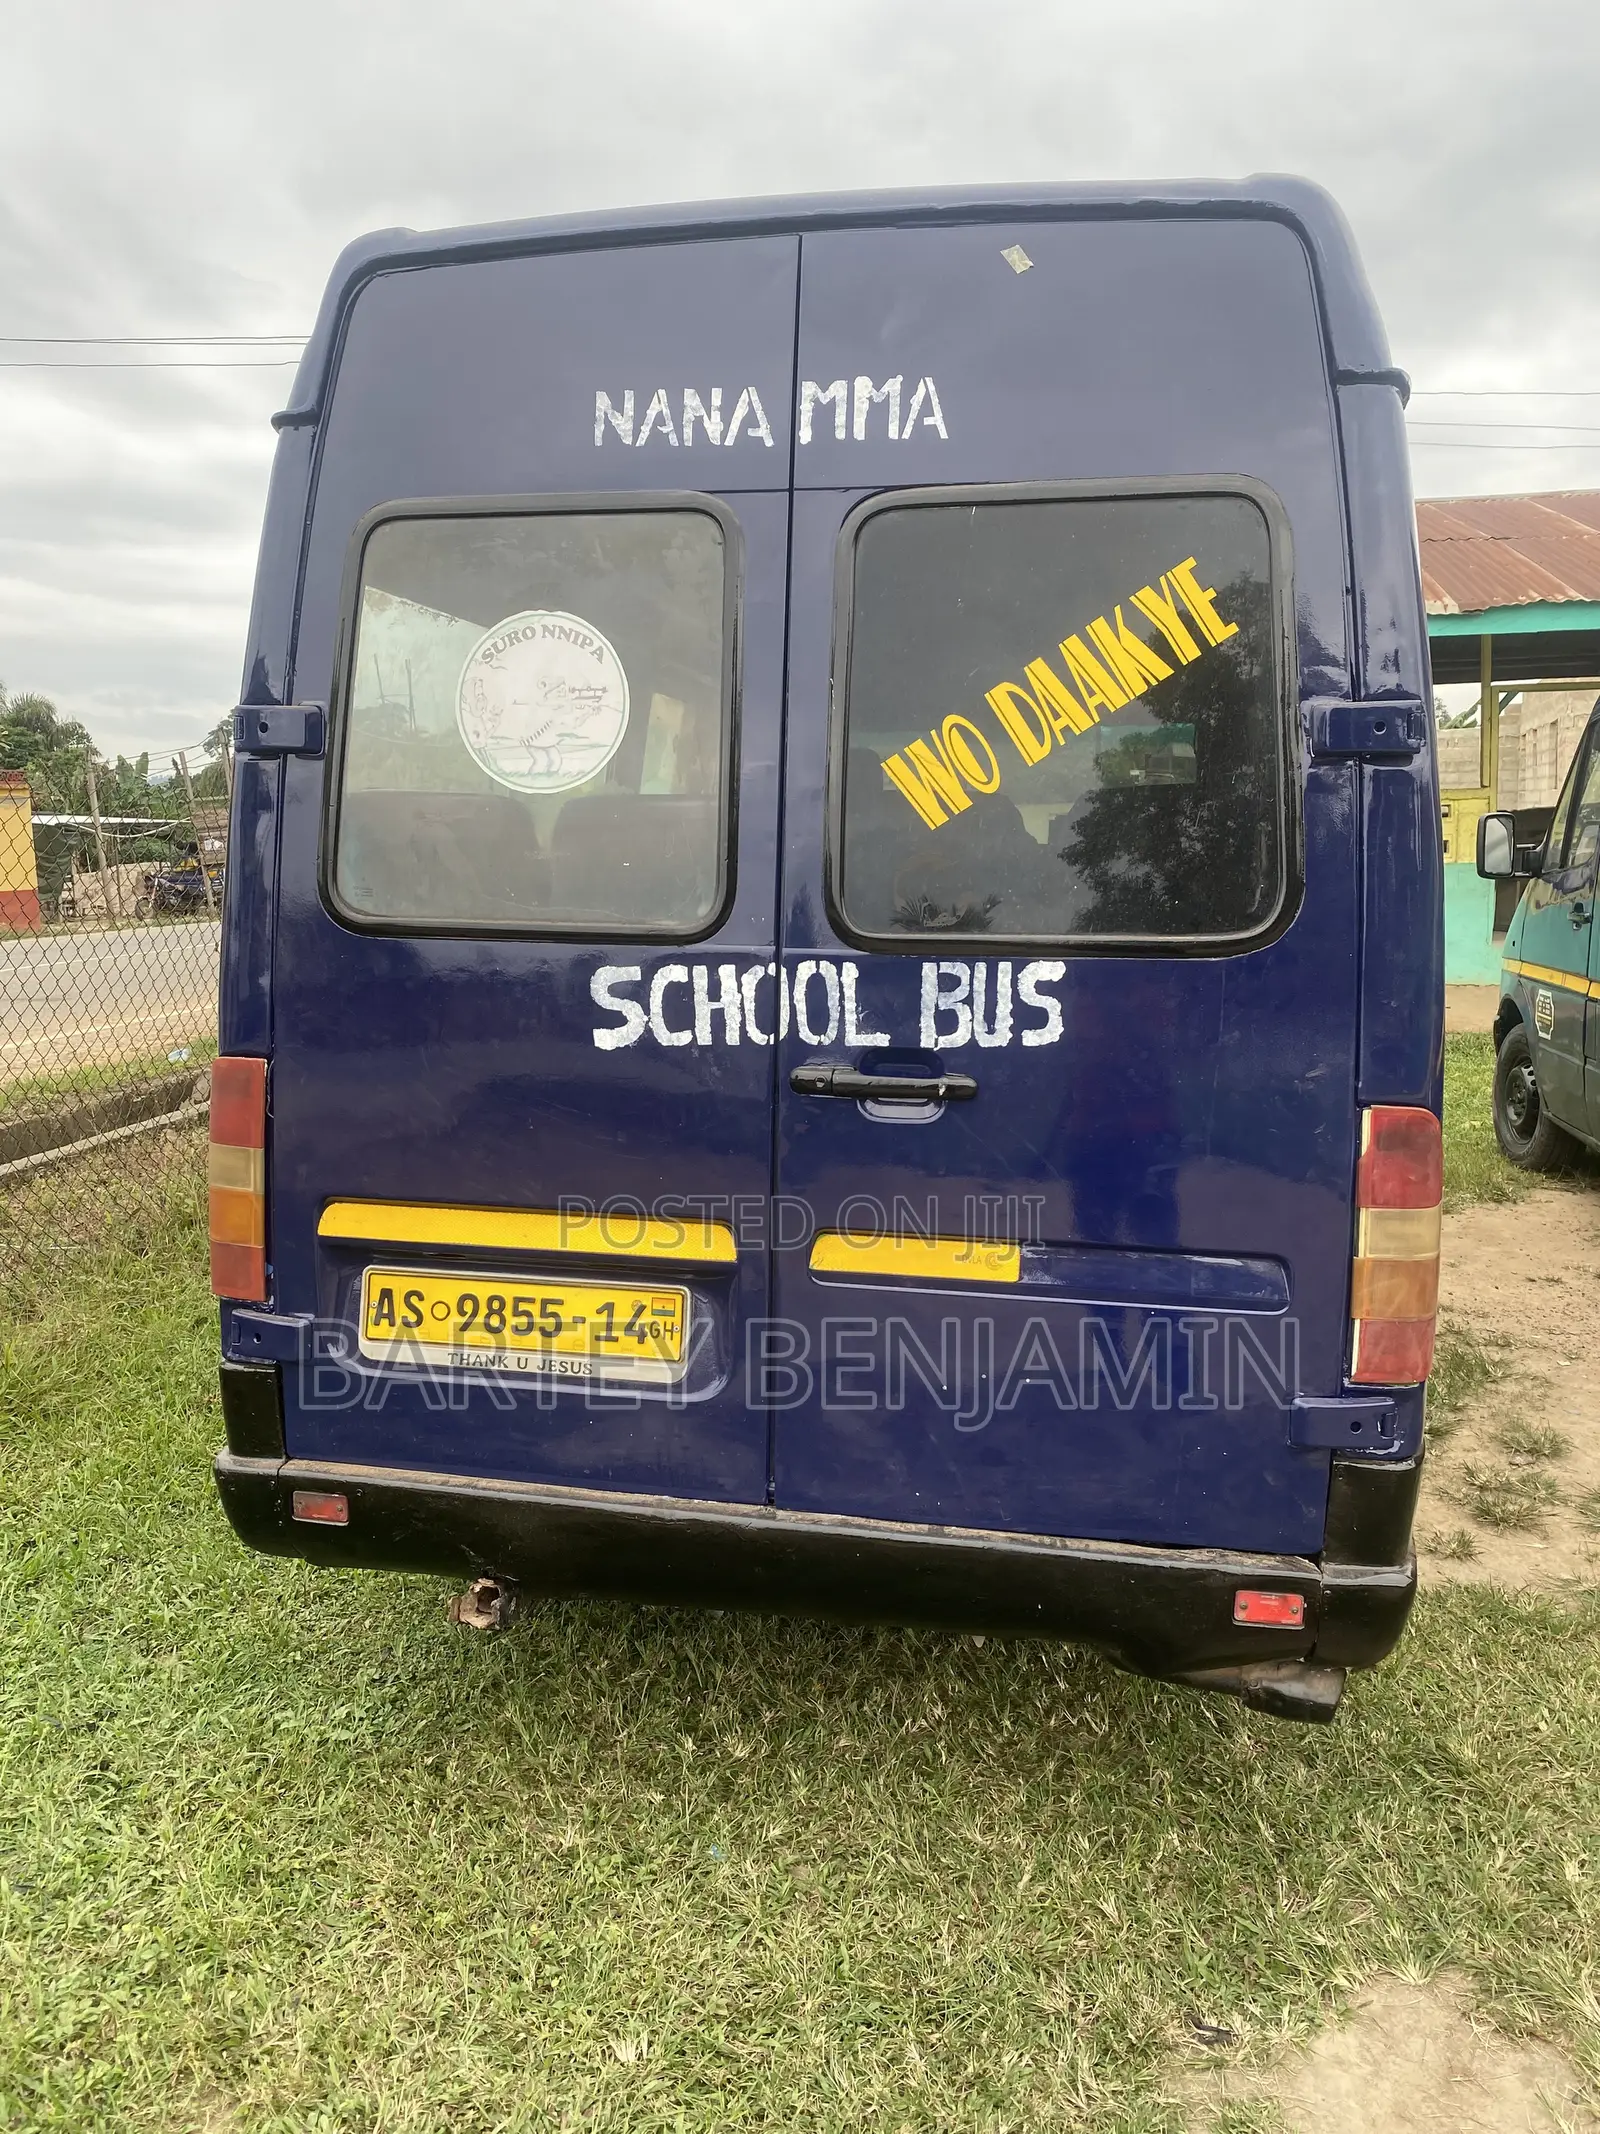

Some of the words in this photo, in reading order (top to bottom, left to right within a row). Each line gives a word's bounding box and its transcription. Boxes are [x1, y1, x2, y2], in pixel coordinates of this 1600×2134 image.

[594, 386, 775, 447] NANA
[799, 374, 949, 445] MMA
[481, 625, 536, 665] SURO
[540, 624, 605, 665] NNIPA
[880, 714, 1001, 831] WO
[984, 555, 1240, 767] DAAKYE
[589, 959, 891, 1052] SCHOOL
[918, 960, 1066, 1051] BUS
[373, 1287, 425, 1329] AS
[650, 1320, 675, 1341] GH
[448, 1352, 509, 1369] THANK
[517, 1357, 528, 1370] U
[537, 1359, 593, 1376] JESUS
